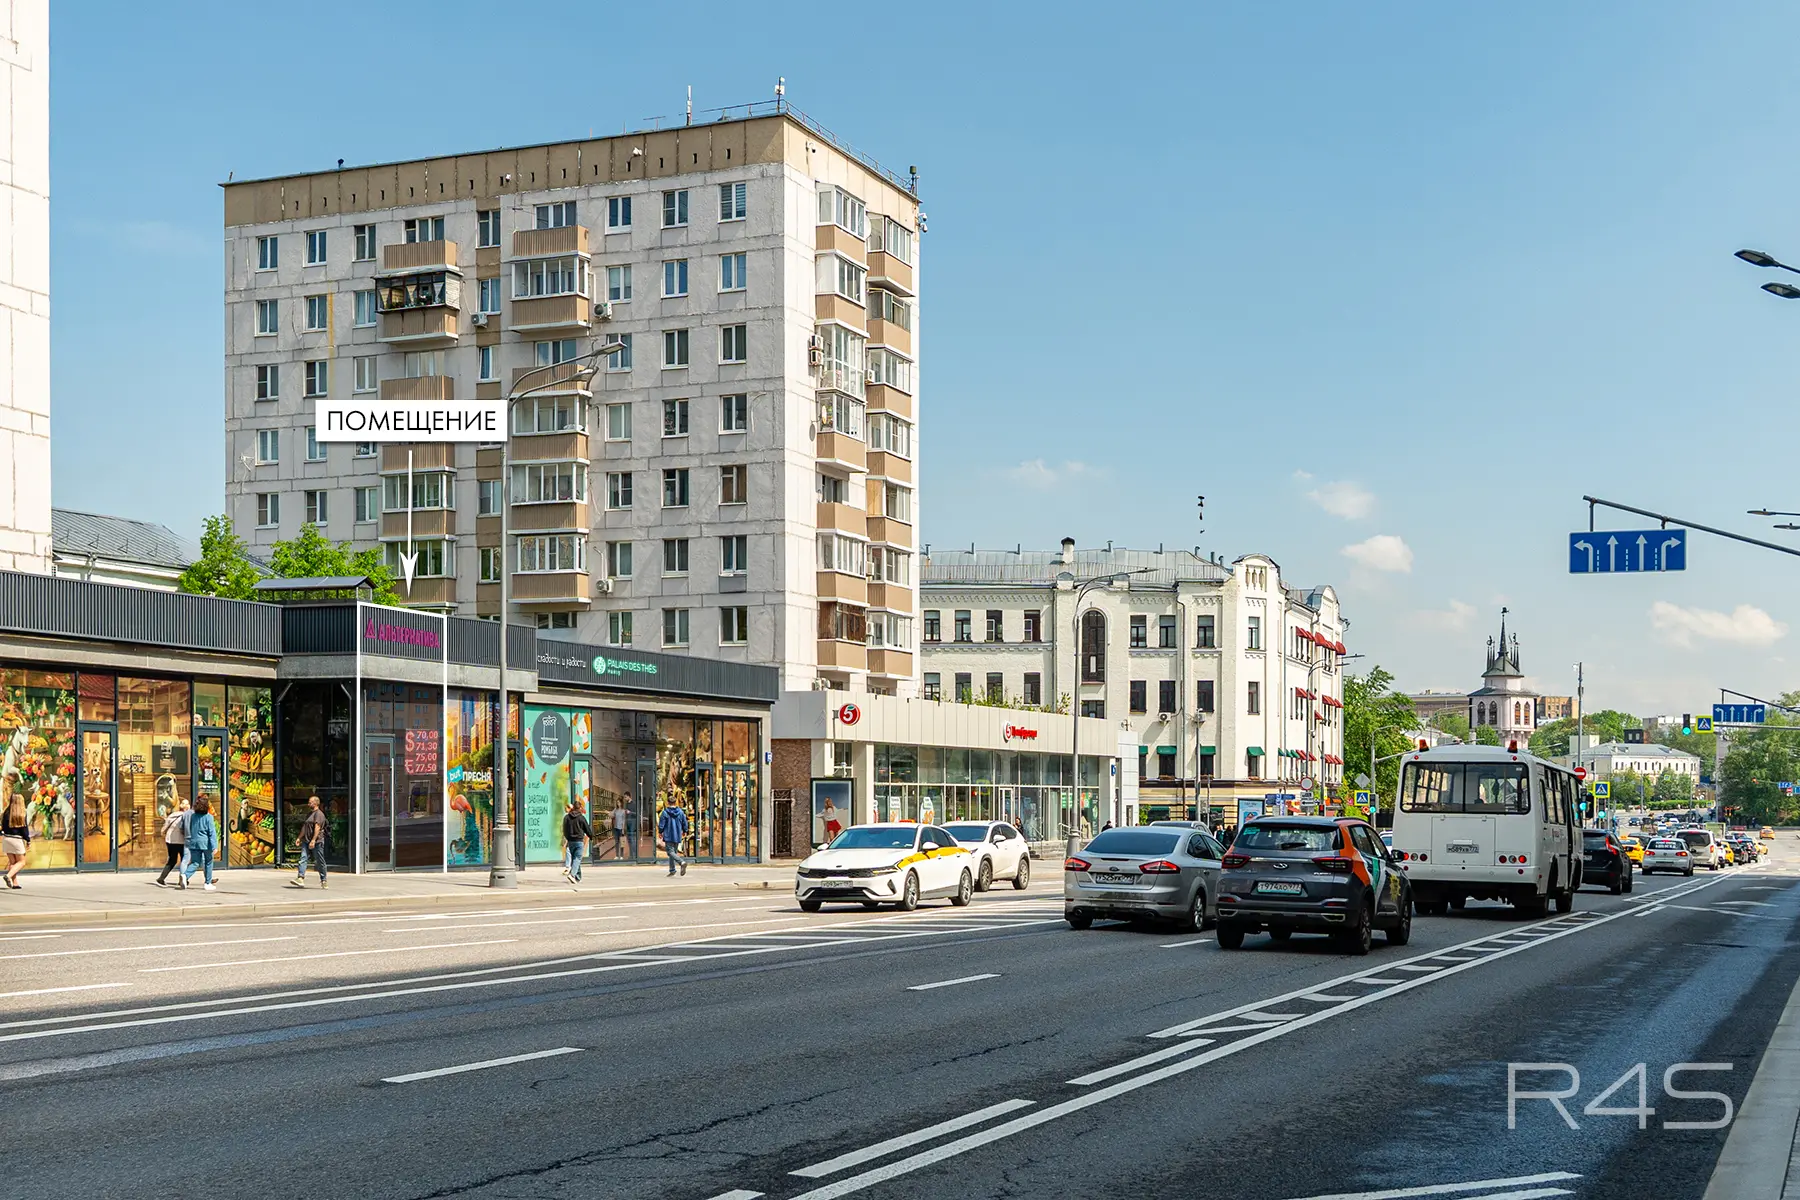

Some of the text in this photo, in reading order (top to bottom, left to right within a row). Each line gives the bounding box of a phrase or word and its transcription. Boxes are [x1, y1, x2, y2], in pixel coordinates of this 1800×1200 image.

[378, 623, 441, 649] АЛЬТЕРНАТИВА
[607, 659, 629, 670] PALAIS
[628, 662, 641, 672] DES
[416, 730, 439, 740] 70,00
[462, 771, 492, 781] ПРЕСНЯ
